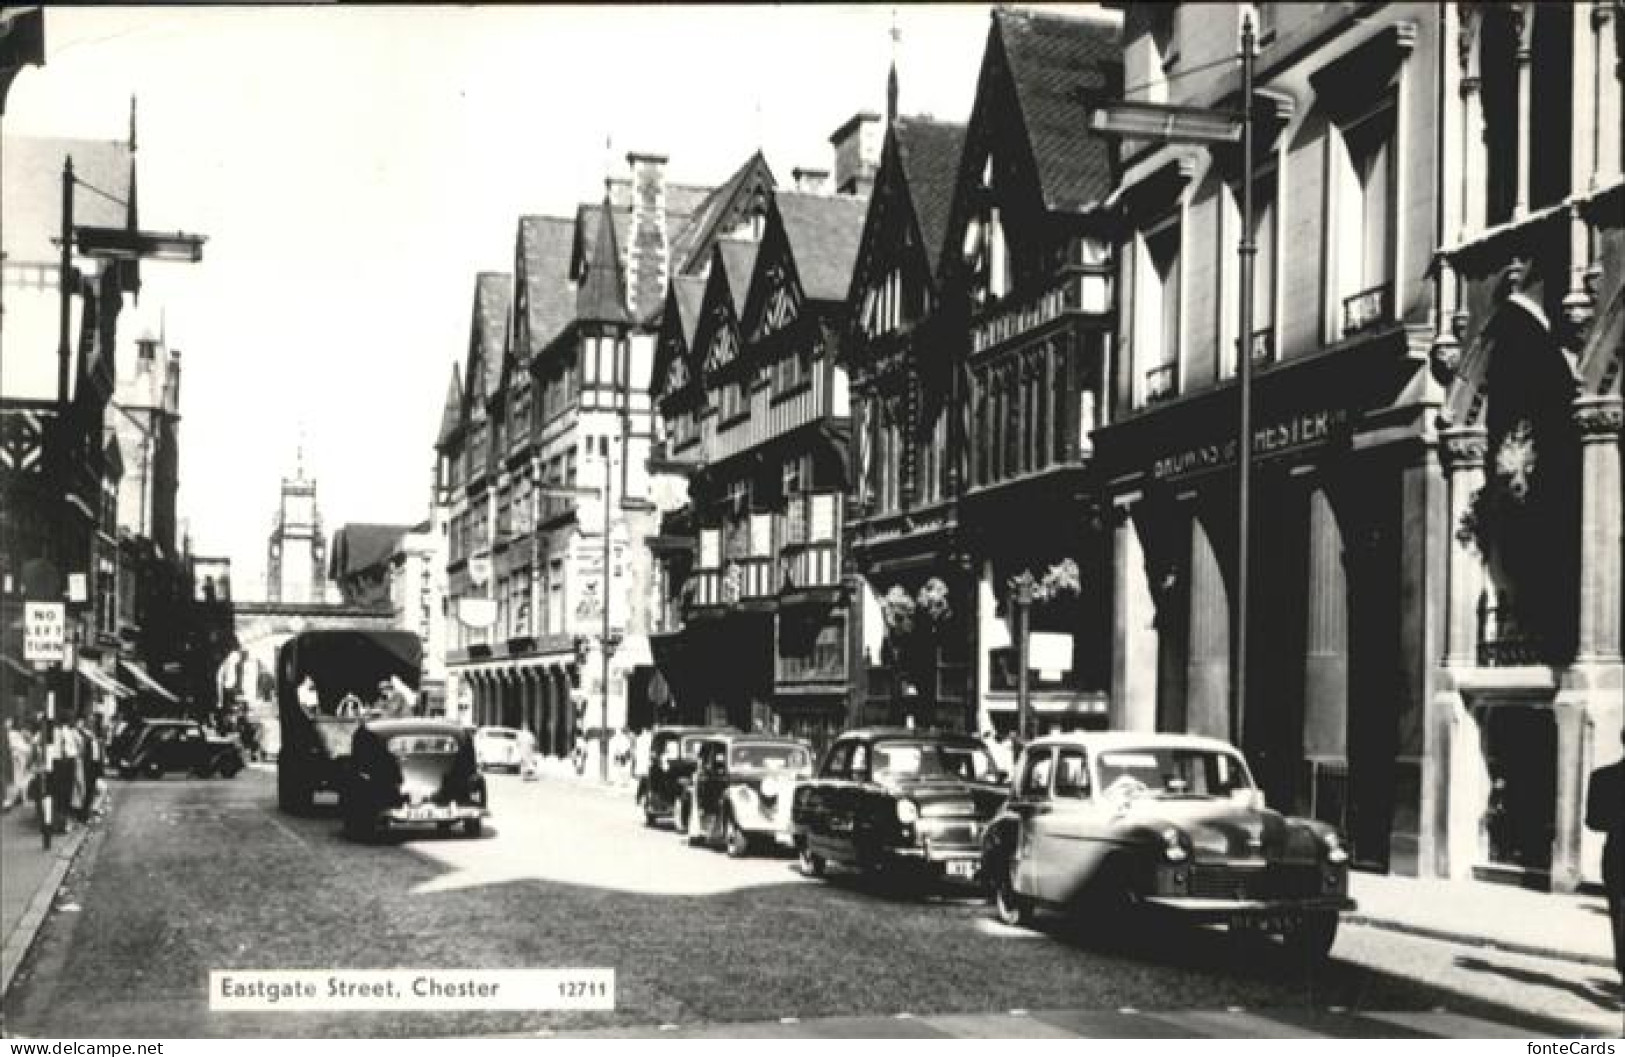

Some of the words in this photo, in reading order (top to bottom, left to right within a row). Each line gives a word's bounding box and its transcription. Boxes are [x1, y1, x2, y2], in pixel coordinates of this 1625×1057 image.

[1252, 408, 1330, 452] HESTER
[34, 610, 57, 621] NO
[26, 624, 61, 636] LEFT
[27, 641, 64, 652] TURN
